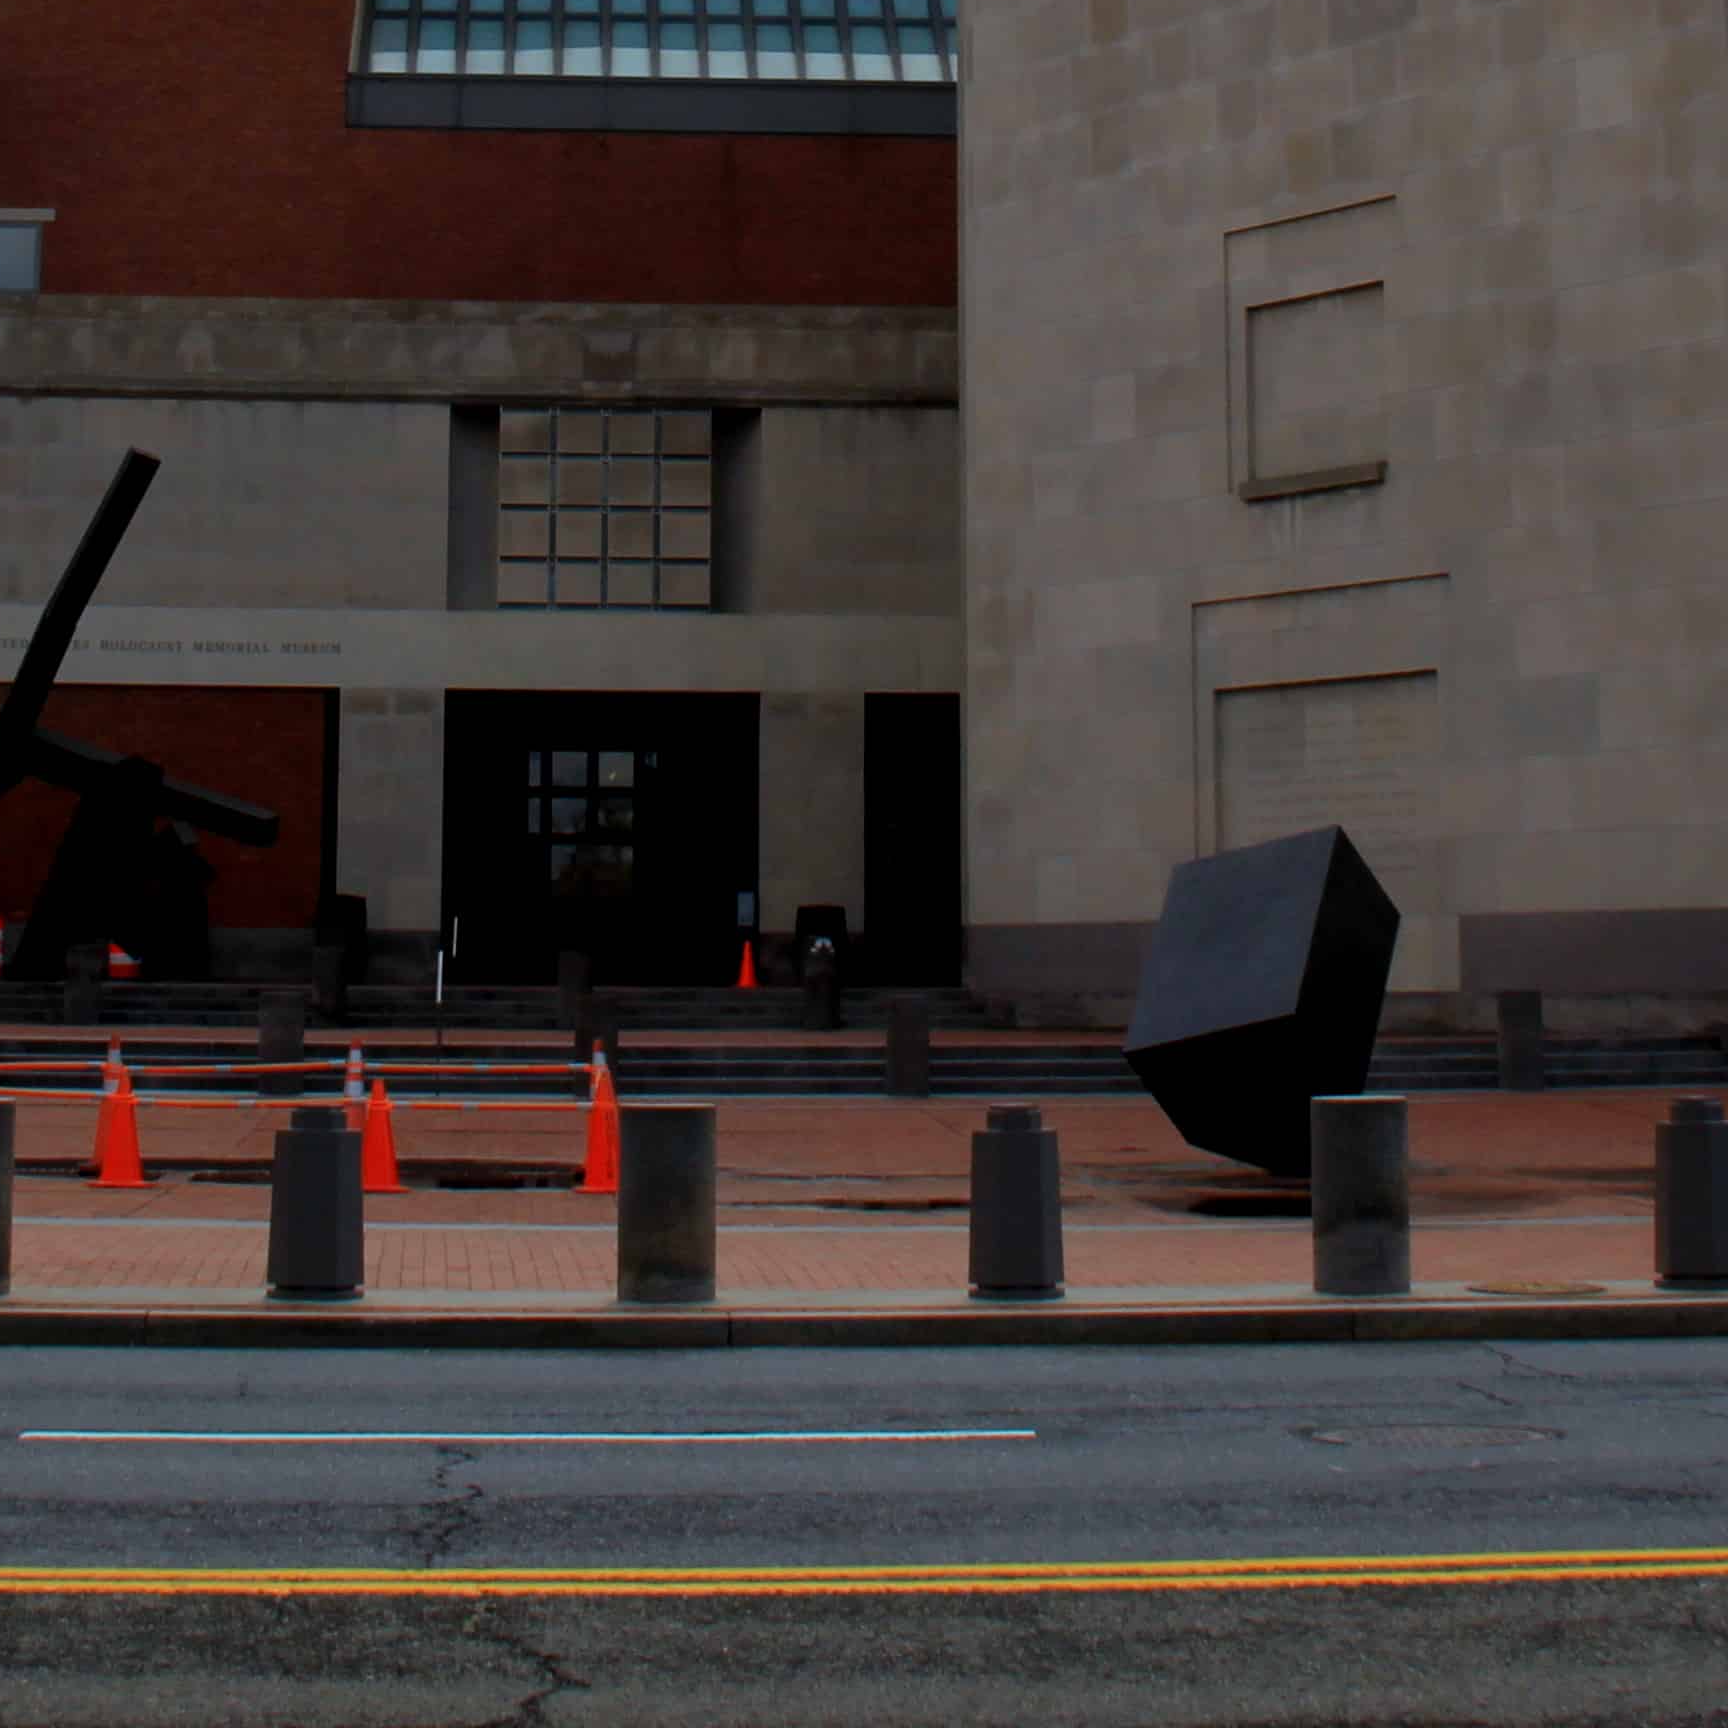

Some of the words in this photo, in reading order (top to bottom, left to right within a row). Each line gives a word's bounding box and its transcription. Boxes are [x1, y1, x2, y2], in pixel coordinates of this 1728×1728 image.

[99, 639, 184, 654] HOLOCAUST
[192, 639, 272, 655] MEMORIAL
[280, 639, 342, 656] MUSEUM
